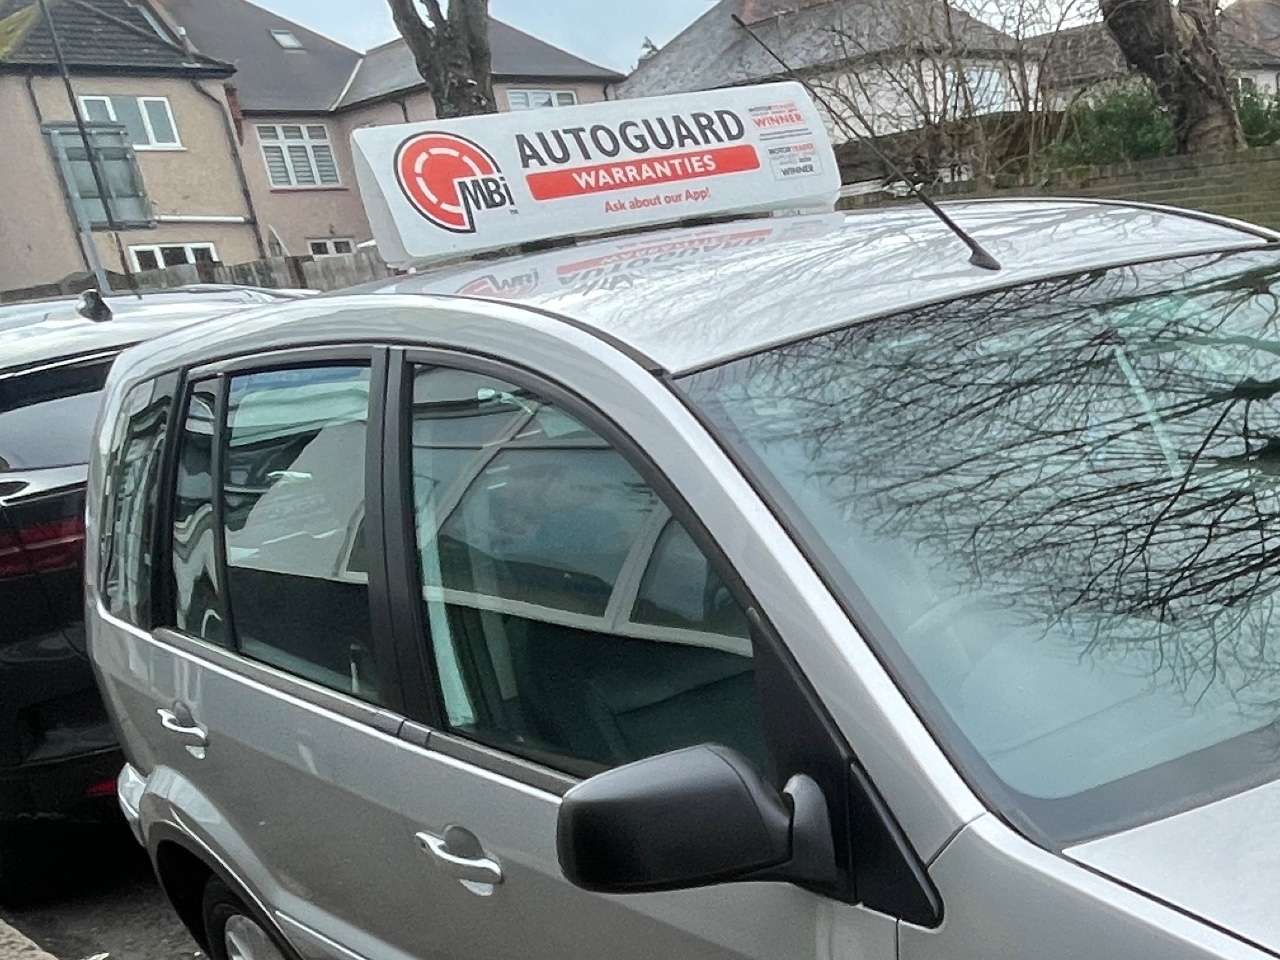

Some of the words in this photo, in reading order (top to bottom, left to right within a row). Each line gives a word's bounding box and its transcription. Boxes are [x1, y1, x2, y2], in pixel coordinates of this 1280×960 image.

[752, 113, 802, 128] WINNER
[515, 110, 745, 168] AUTOGUARD
[572, 154, 717, 189] WARRANTIES
[781, 164, 815, 176] WINNER
[457, 176, 515, 211] MBi
[605, 200, 627, 213] Ask
[629, 194, 662, 209] about
[664, 193, 682, 204] our
[685, 186, 712, 201] App!
